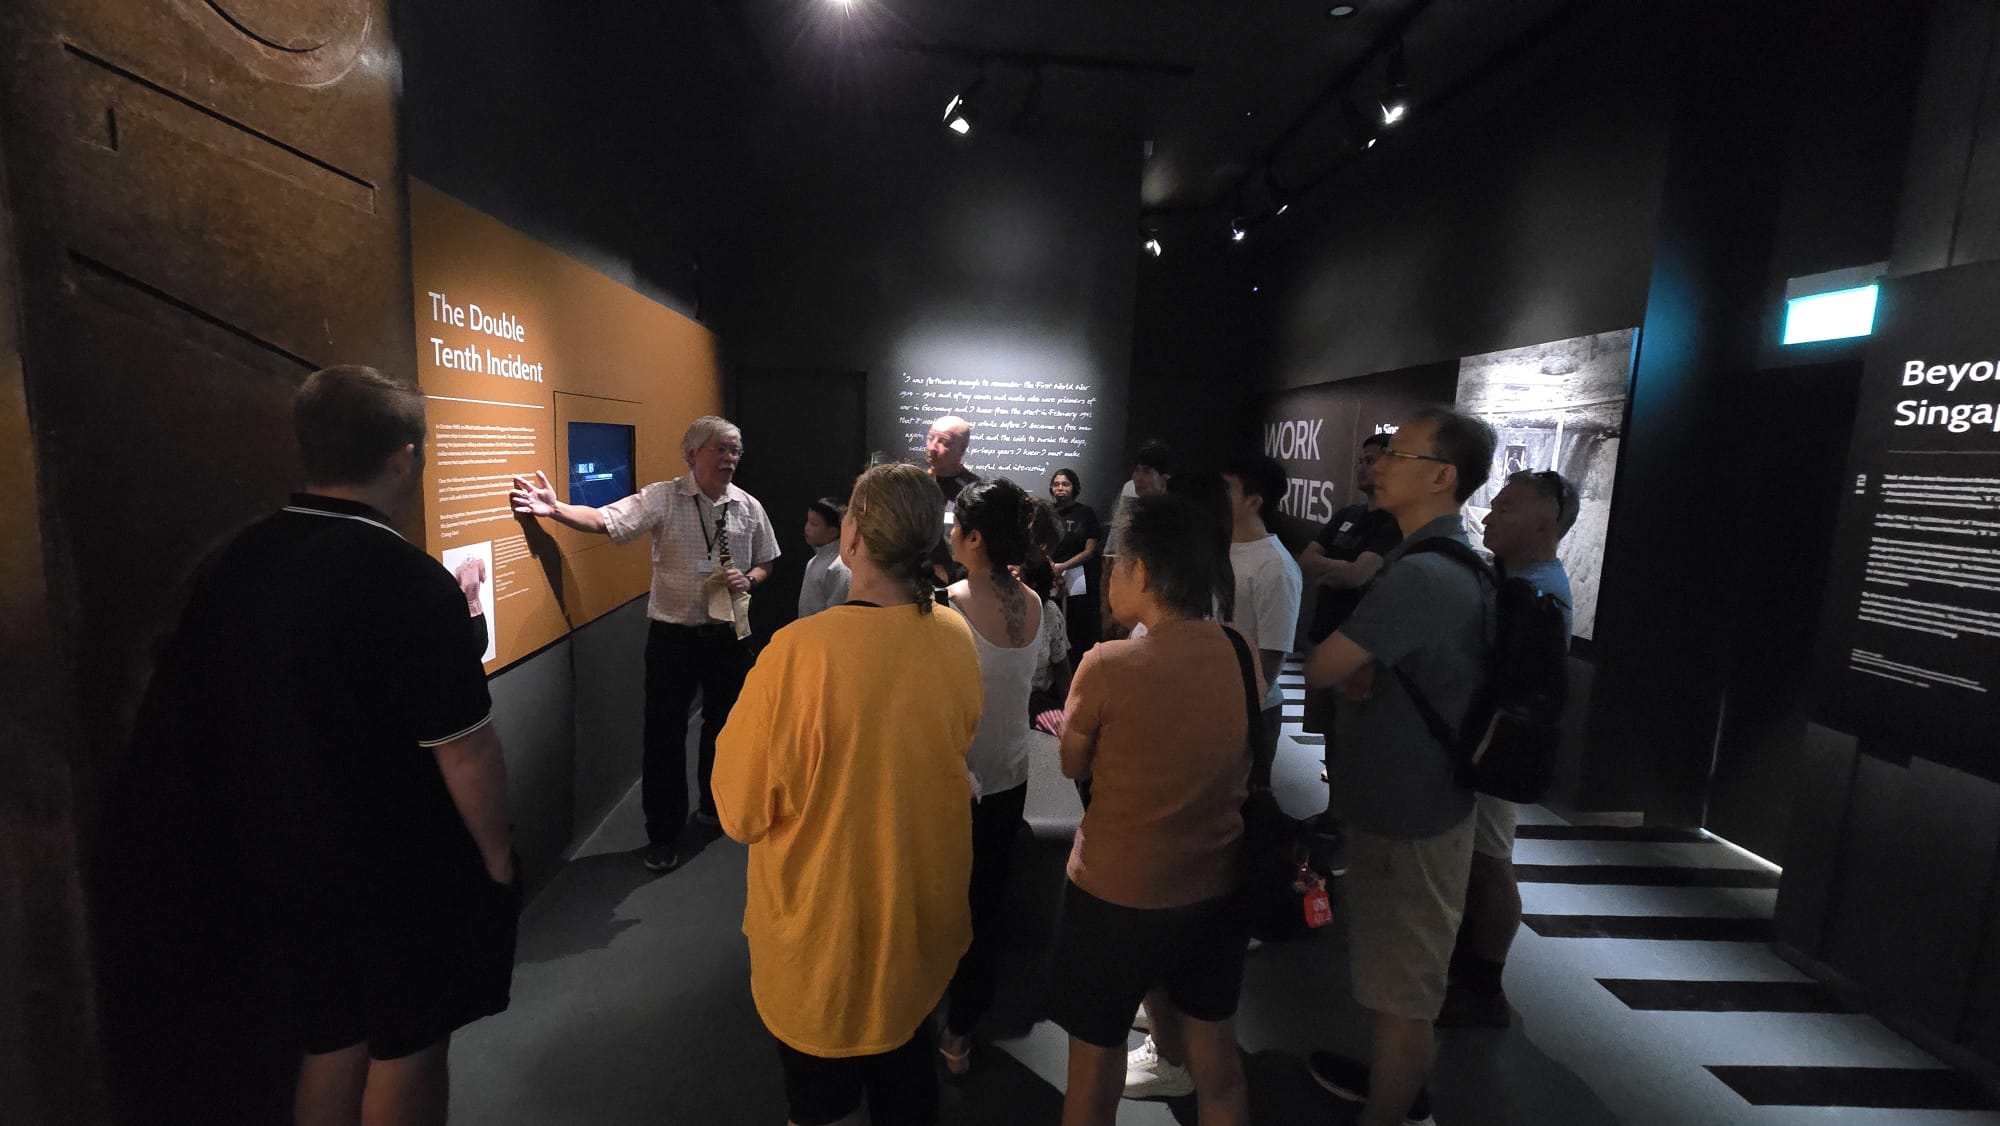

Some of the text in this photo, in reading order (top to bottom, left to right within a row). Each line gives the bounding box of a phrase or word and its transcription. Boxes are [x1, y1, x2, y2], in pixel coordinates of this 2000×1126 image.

[428, 291, 525, 343] The Double
[430, 336, 544, 383] Tenth Incident
[1264, 418, 1324, 461] WORK
[1278, 476, 1335, 525] RTIES
